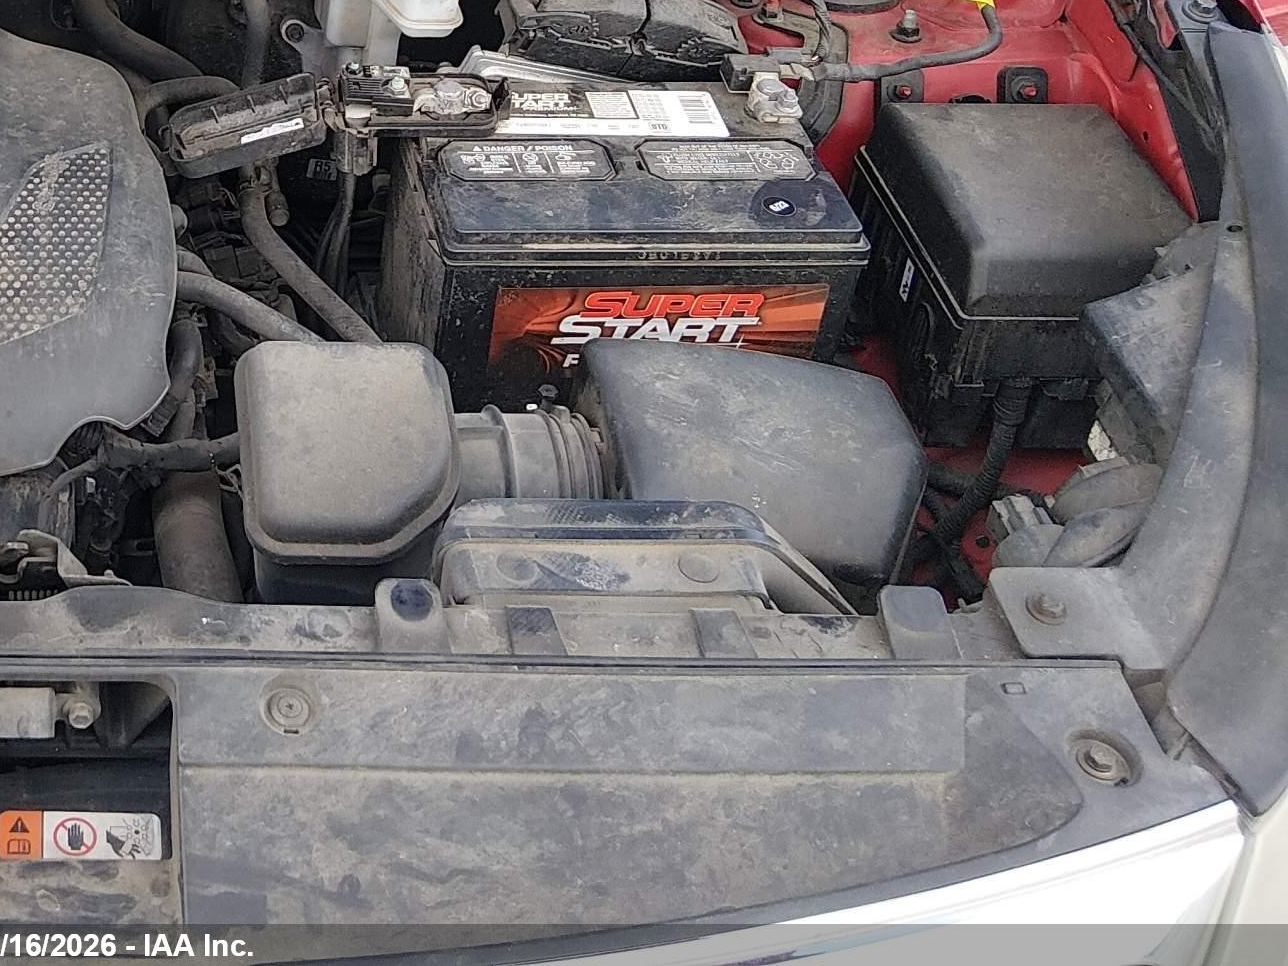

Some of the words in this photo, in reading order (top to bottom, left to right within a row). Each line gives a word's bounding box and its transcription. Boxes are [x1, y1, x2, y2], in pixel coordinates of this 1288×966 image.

[511, 100, 571, 109] TART
[579, 291, 765, 318] SUPER
[550, 315, 761, 345] START
